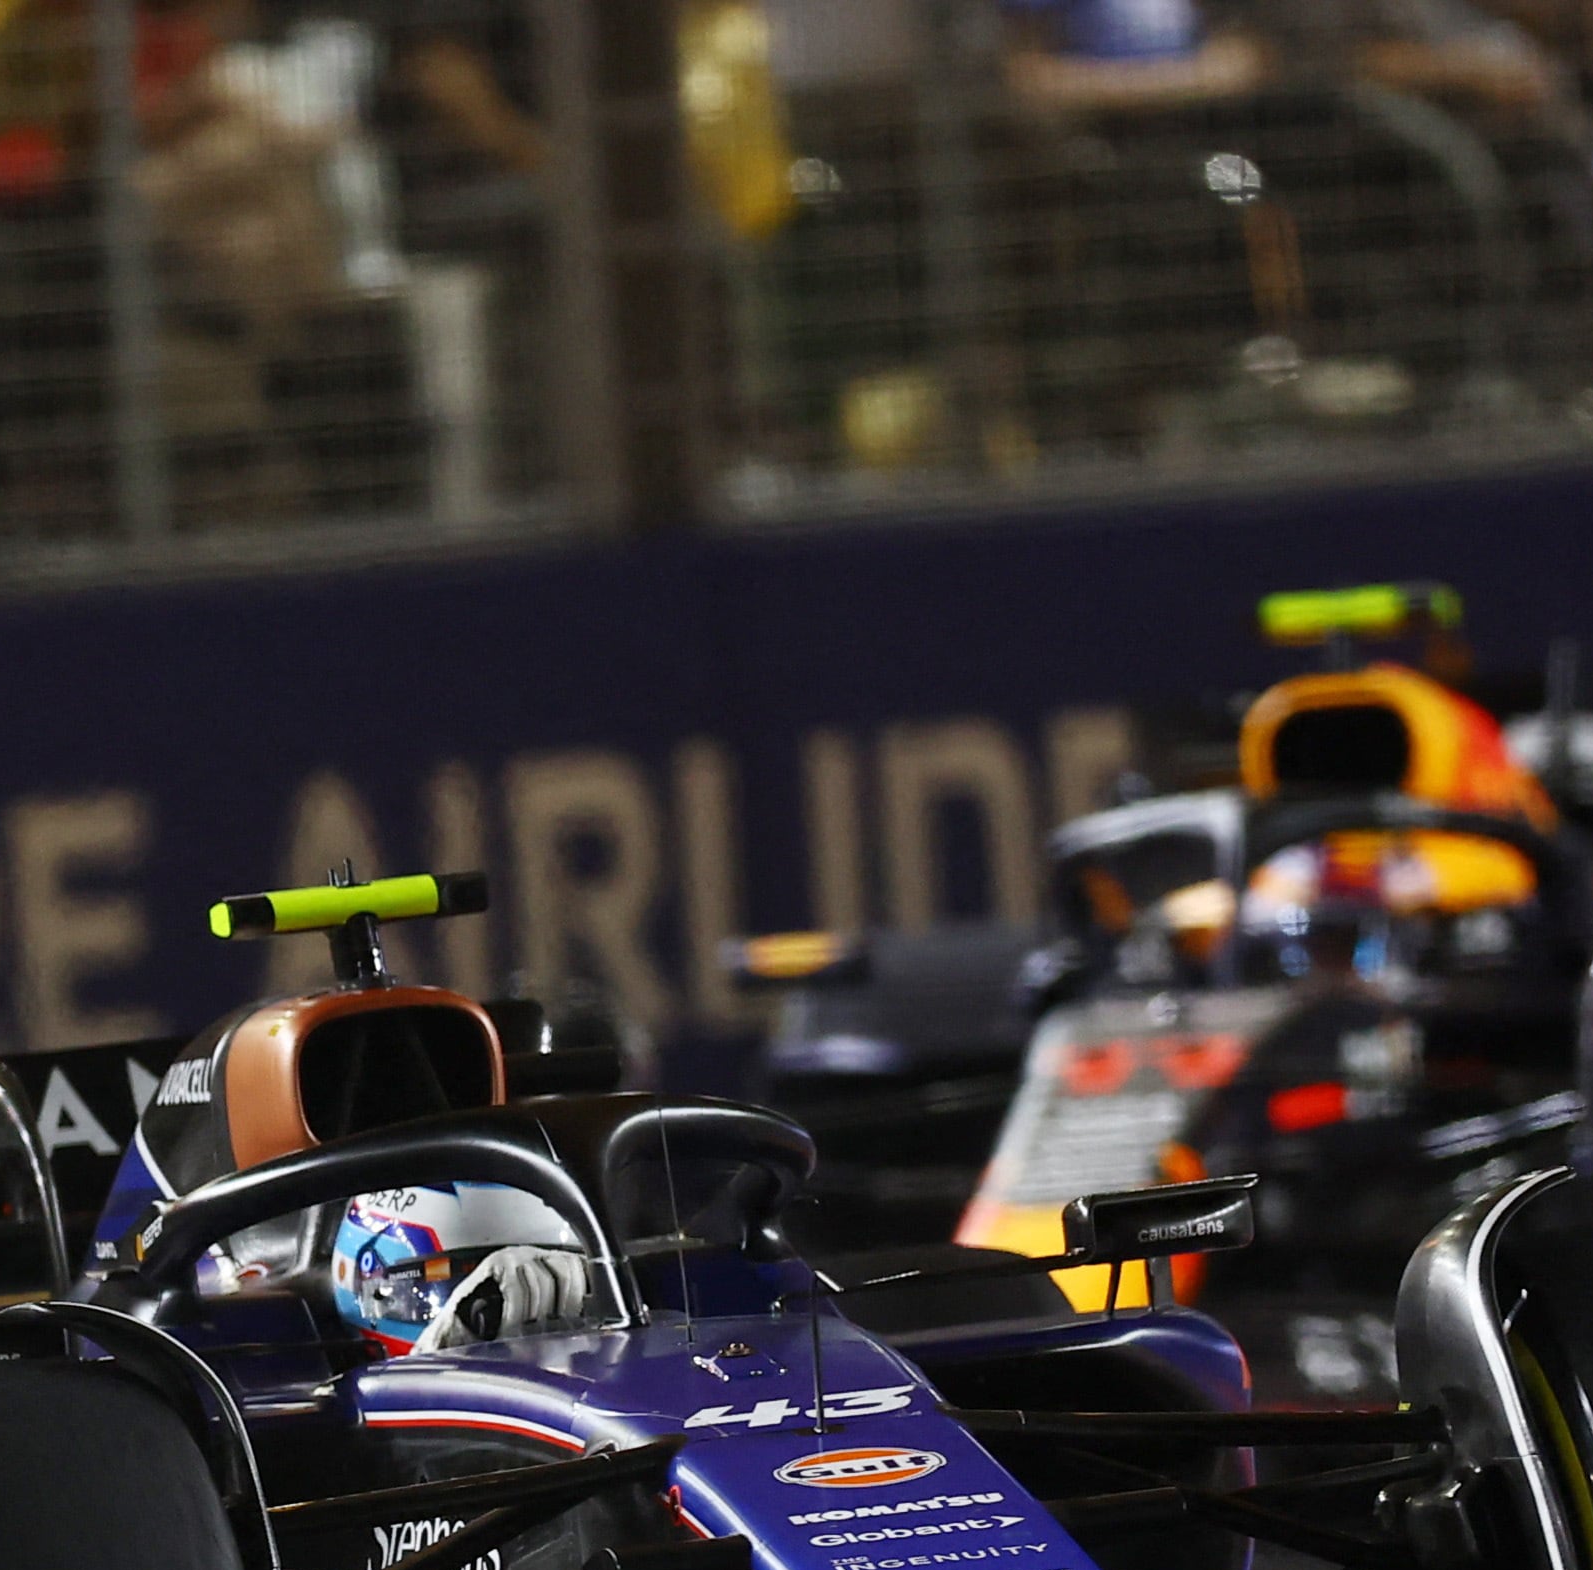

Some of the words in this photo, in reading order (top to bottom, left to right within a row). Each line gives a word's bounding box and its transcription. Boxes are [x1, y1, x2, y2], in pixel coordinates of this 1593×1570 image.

[683, 1382, 917, 1428] 43
[786, 1454, 932, 1480] Gulf
[787, 1491, 1005, 1526] KOMATSU
[809, 1516, 994, 1547] Globant
